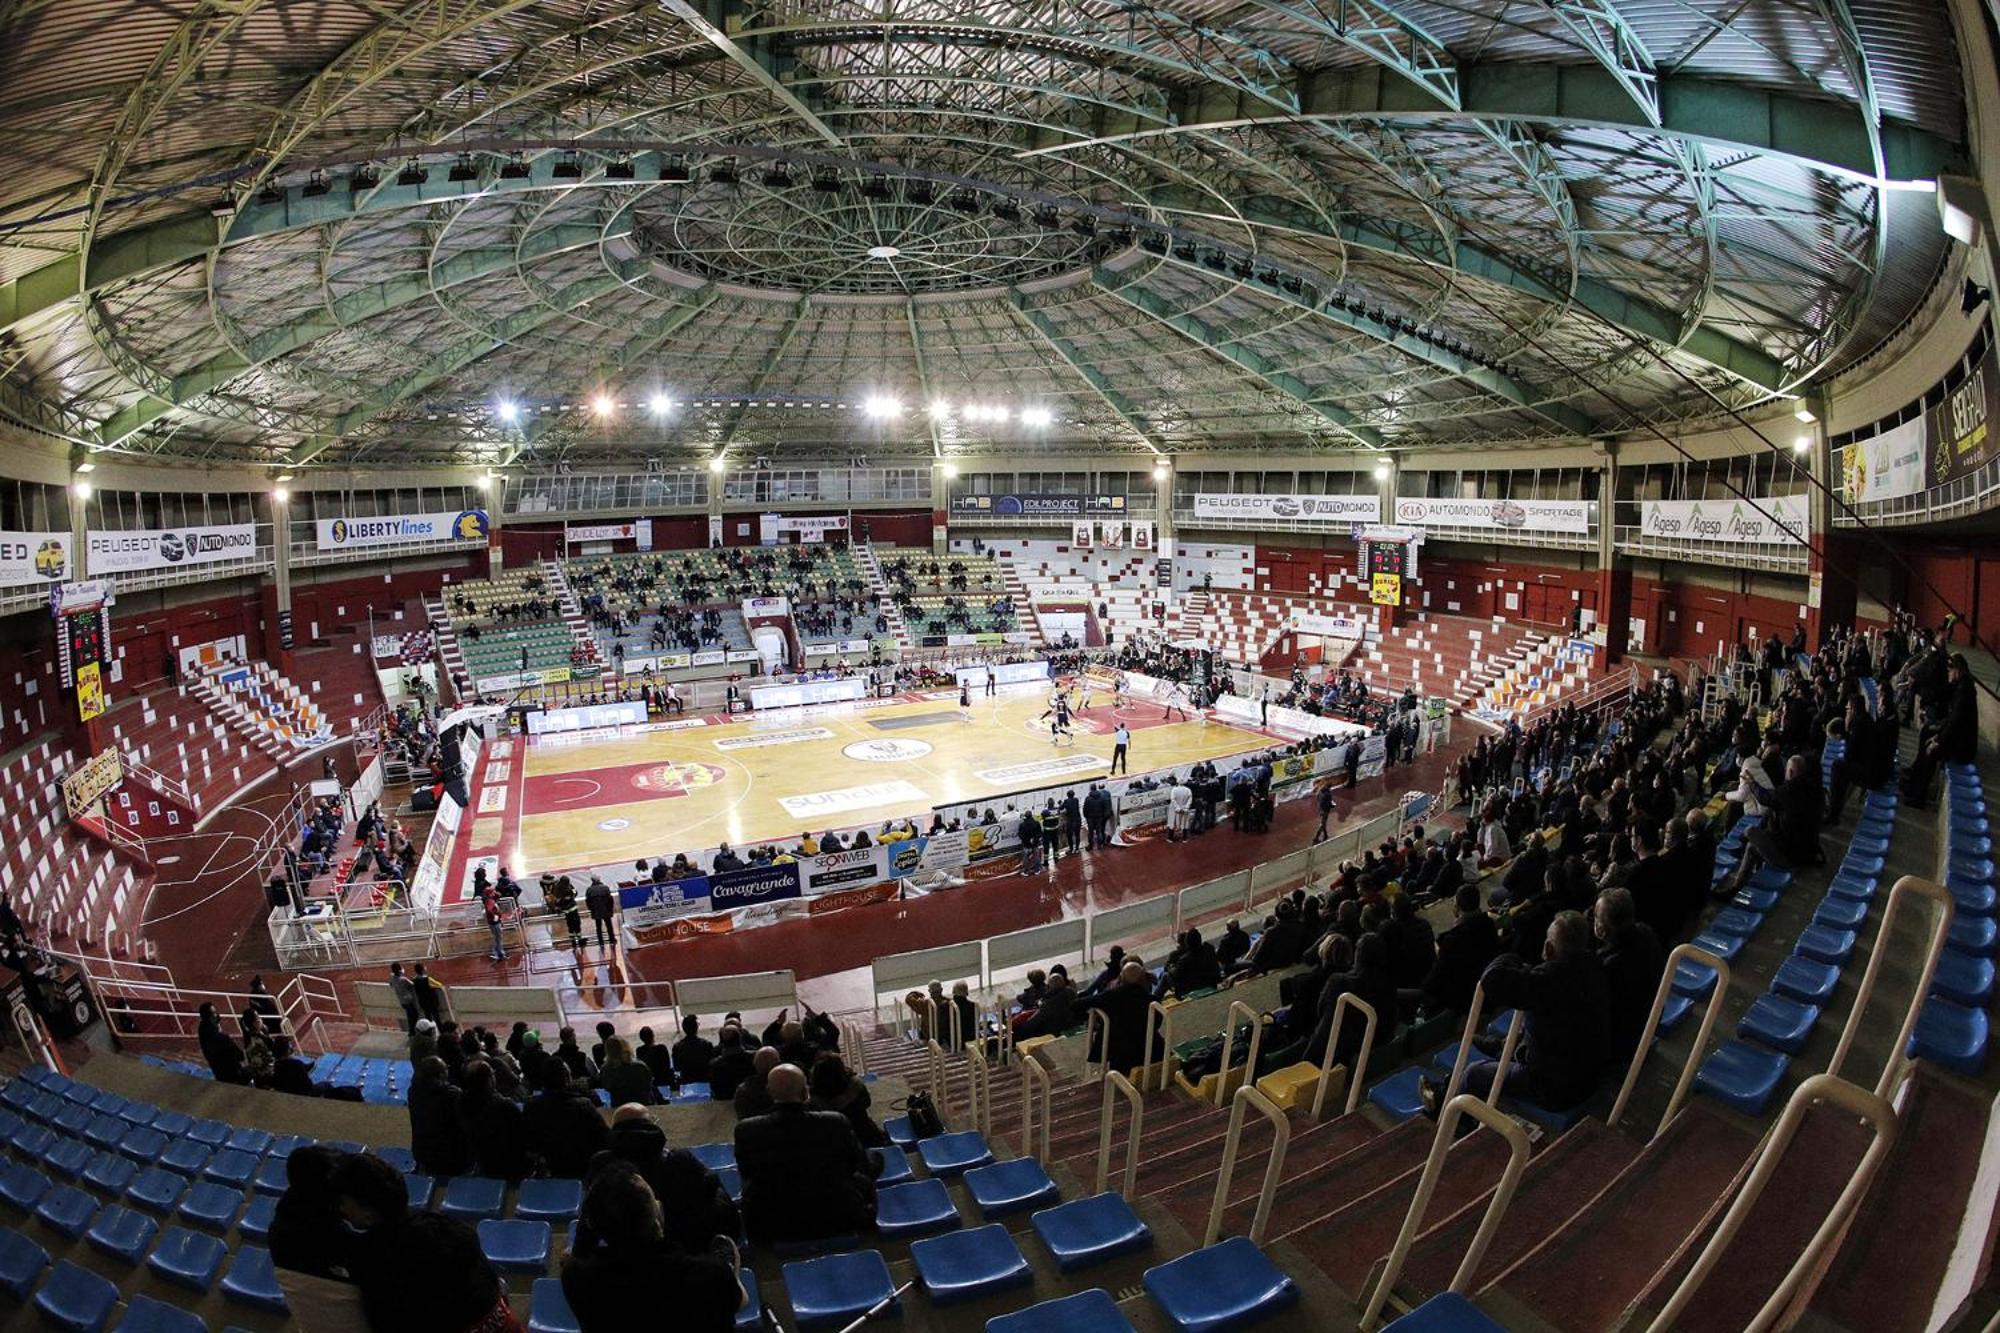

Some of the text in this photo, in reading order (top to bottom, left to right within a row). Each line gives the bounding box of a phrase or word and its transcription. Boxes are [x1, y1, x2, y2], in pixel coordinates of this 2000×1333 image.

[952, 497, 991, 508] HAB
[1086, 496, 1124, 508] HAB
[1198, 498, 1272, 507] PEUGEOT
[1316, 501, 1375, 513] AUTOMONDO
[1403, 504, 1423, 516] KIA
[1429, 504, 1490, 516] AUTOMONDO
[1653, 516, 1681, 535] Agesp
[1693, 517, 1721, 538] Agesp
[1734, 517, 1762, 540] Agesp
[1774, 518, 1803, 541] Agesp
[91, 537, 158, 553] PEUGEOT
[200, 533, 251, 552] AUTOMONDO
[713, 874, 796, 898] Cavagrande
